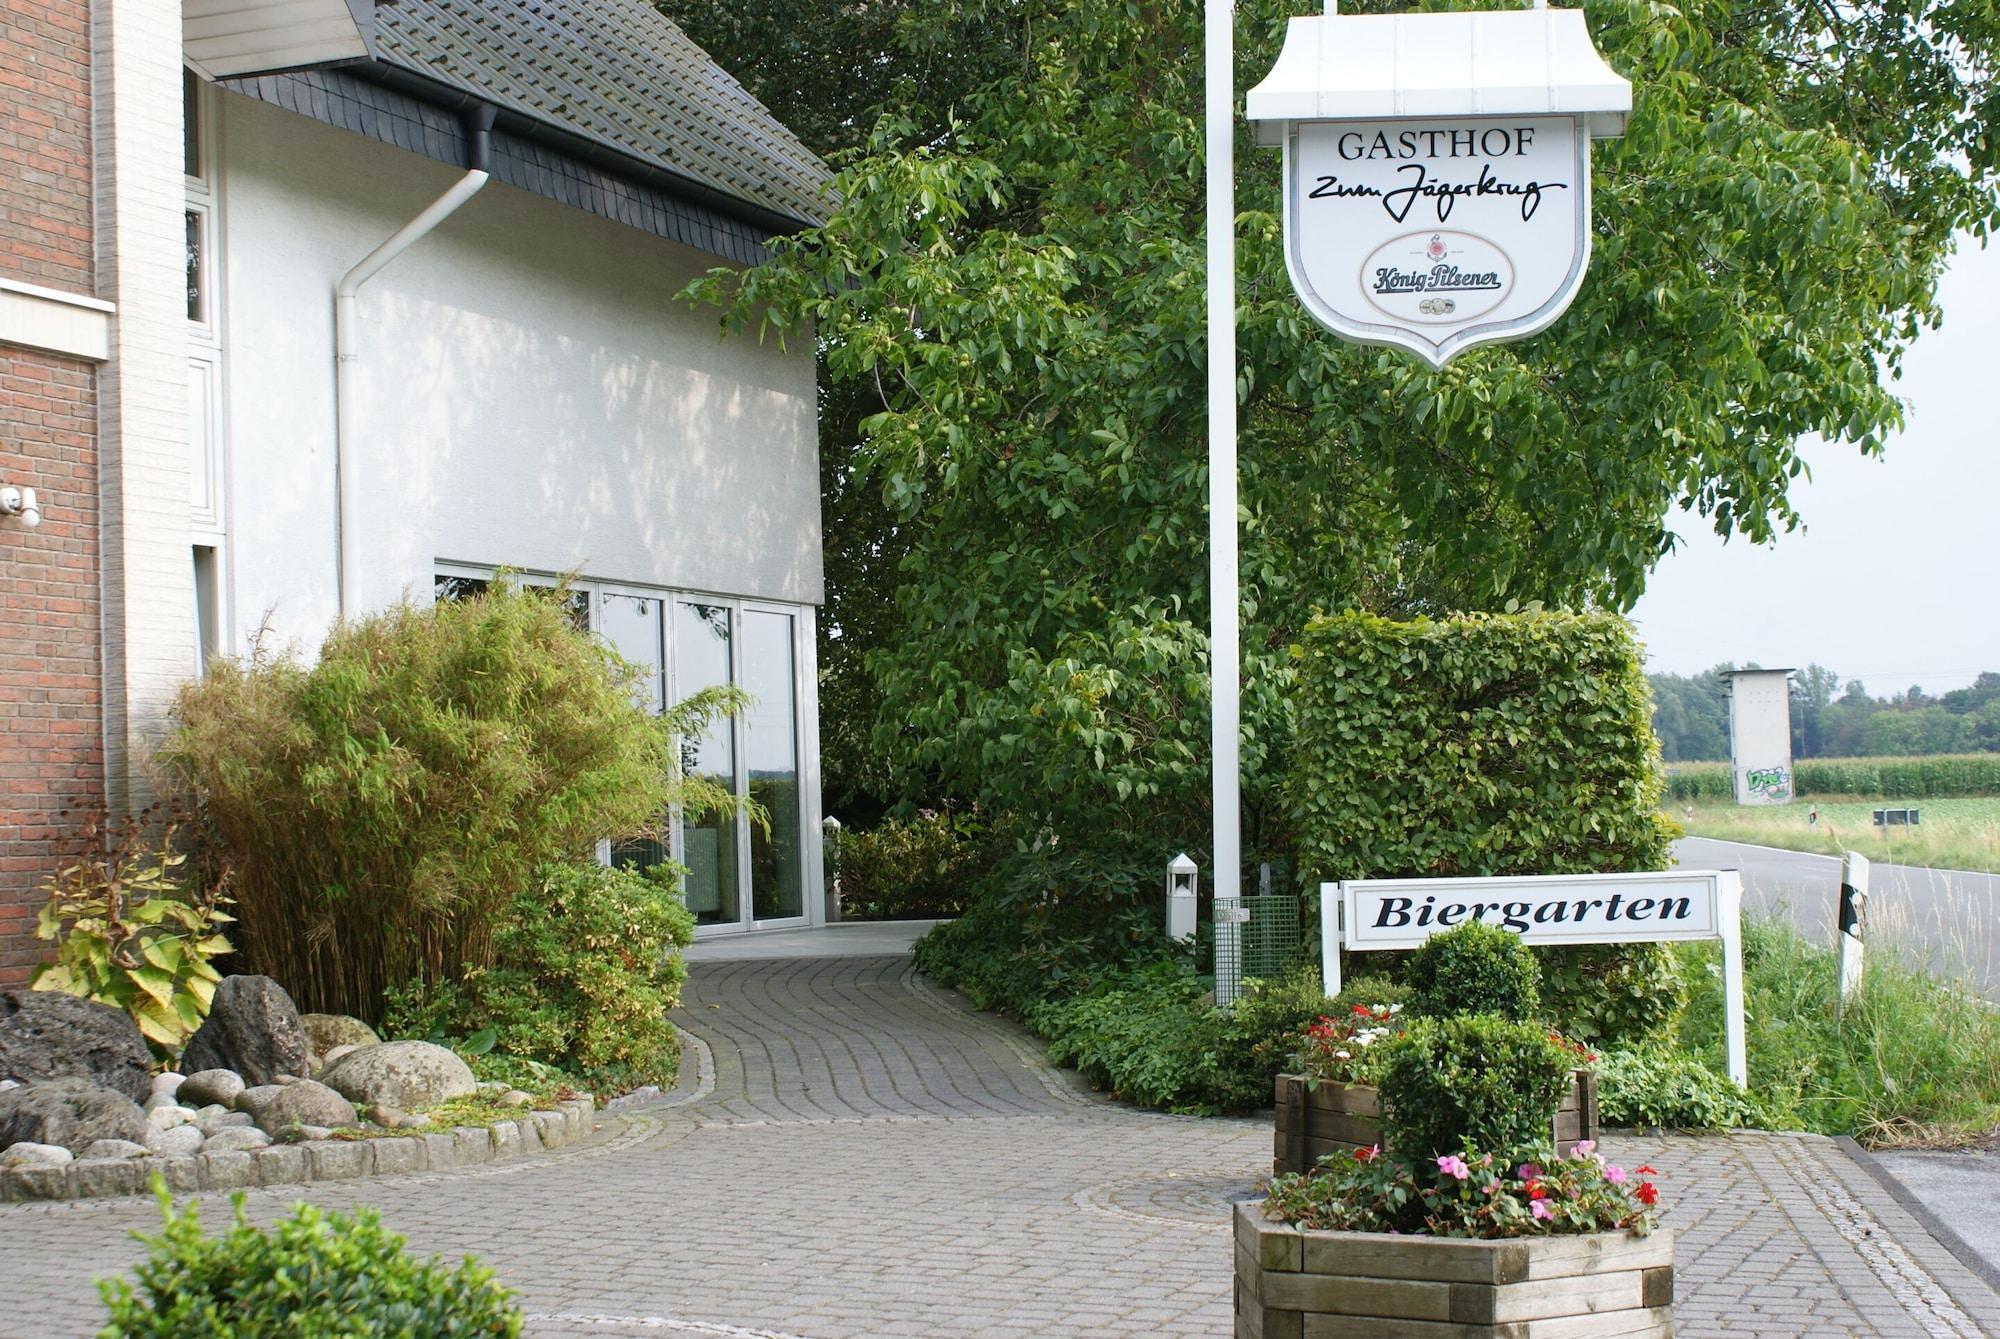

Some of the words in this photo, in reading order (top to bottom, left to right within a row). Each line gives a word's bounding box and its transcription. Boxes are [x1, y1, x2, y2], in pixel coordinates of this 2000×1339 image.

[1338, 128, 1535, 160] GASTHOF
[1373, 264, 1501, 293] König-Pilsener
[1371, 894, 1691, 933] Biergarten
